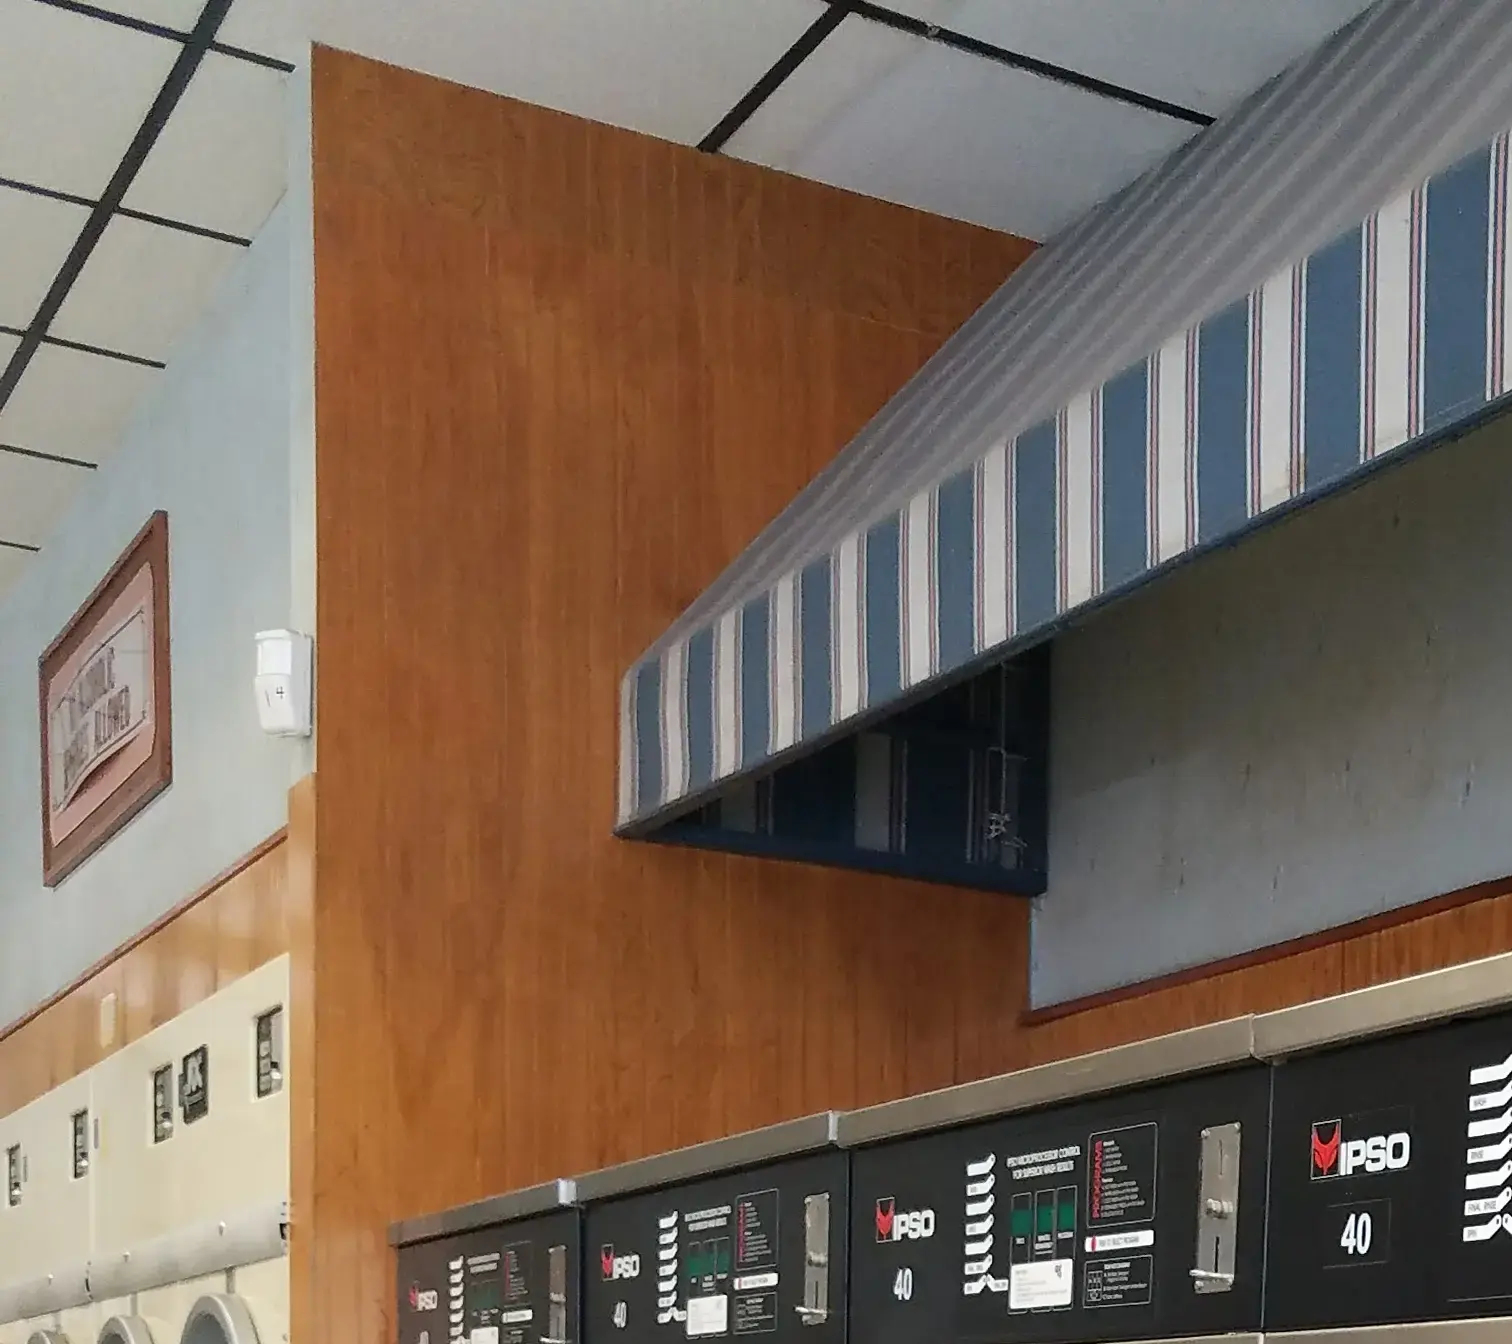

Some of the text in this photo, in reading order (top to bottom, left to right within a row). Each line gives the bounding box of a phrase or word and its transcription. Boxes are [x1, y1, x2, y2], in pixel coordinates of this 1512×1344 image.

[1339, 1132, 1410, 1176] IPSO
[893, 1209, 935, 1241] IPSO
[1340, 1212, 1372, 1255] 40
[893, 1267, 913, 1301] 40
